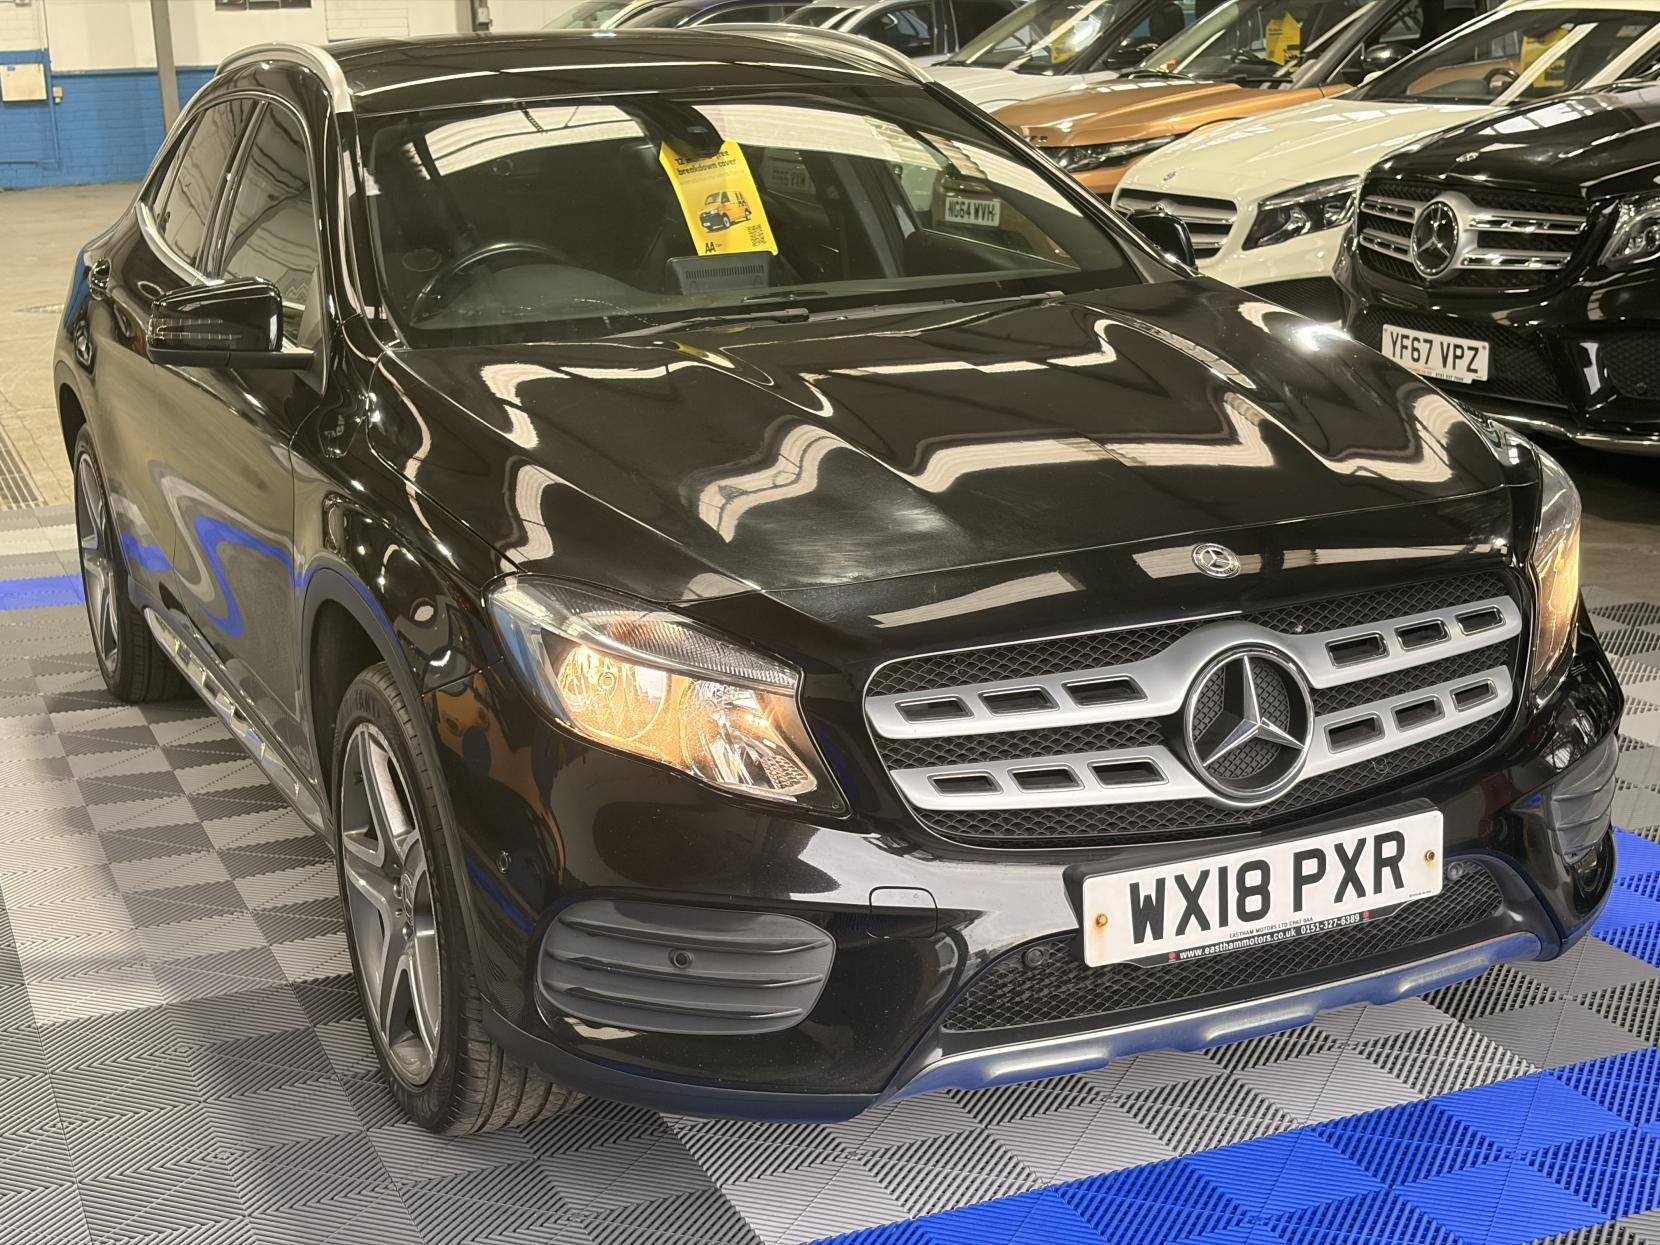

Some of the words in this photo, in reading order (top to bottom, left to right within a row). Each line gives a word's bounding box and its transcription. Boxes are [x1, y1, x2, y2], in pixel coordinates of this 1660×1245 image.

[677, 163, 717, 176] breakdown
[718, 159, 737, 168] cover
[705, 242, 716, 253] AA
[1390, 330, 1434, 366] YF67
[1439, 340, 1480, 374] VPZ
[1129, 858, 1272, 945] WX18
[1292, 829, 1406, 913] PXR
[1179, 928, 1297, 960] www.easthammotors.co.uk
[1300, 912, 1361, 935] 0151-327-6389
[1229, 929, 1254, 938] EASTHAM
[1255, 924, 1278, 933] MOTORS
